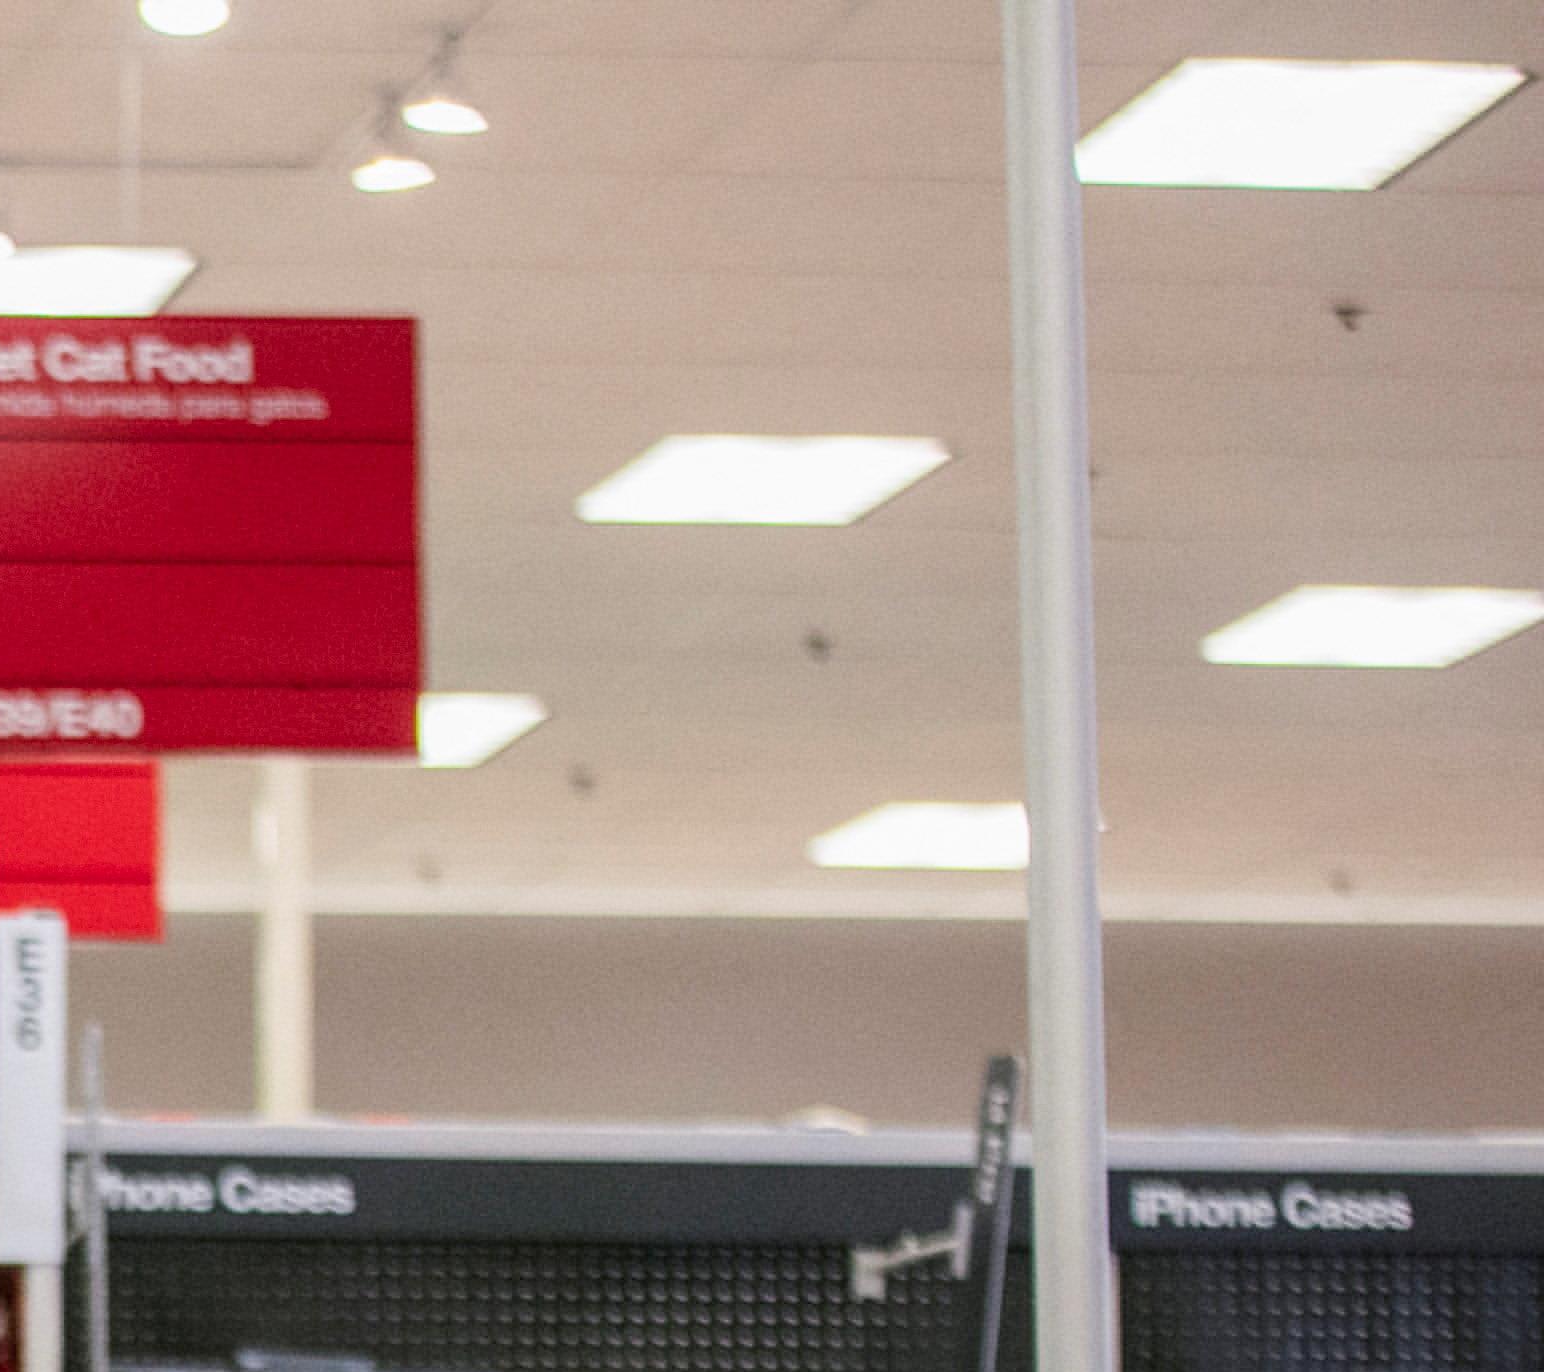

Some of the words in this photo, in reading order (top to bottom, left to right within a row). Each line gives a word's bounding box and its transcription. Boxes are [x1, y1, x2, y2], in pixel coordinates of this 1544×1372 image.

[42, 334, 127, 383] Cat
[130, 334, 254, 383] Food
[220, 1164, 357, 1215] Cases
[1280, 1178, 1415, 1229] Cases
